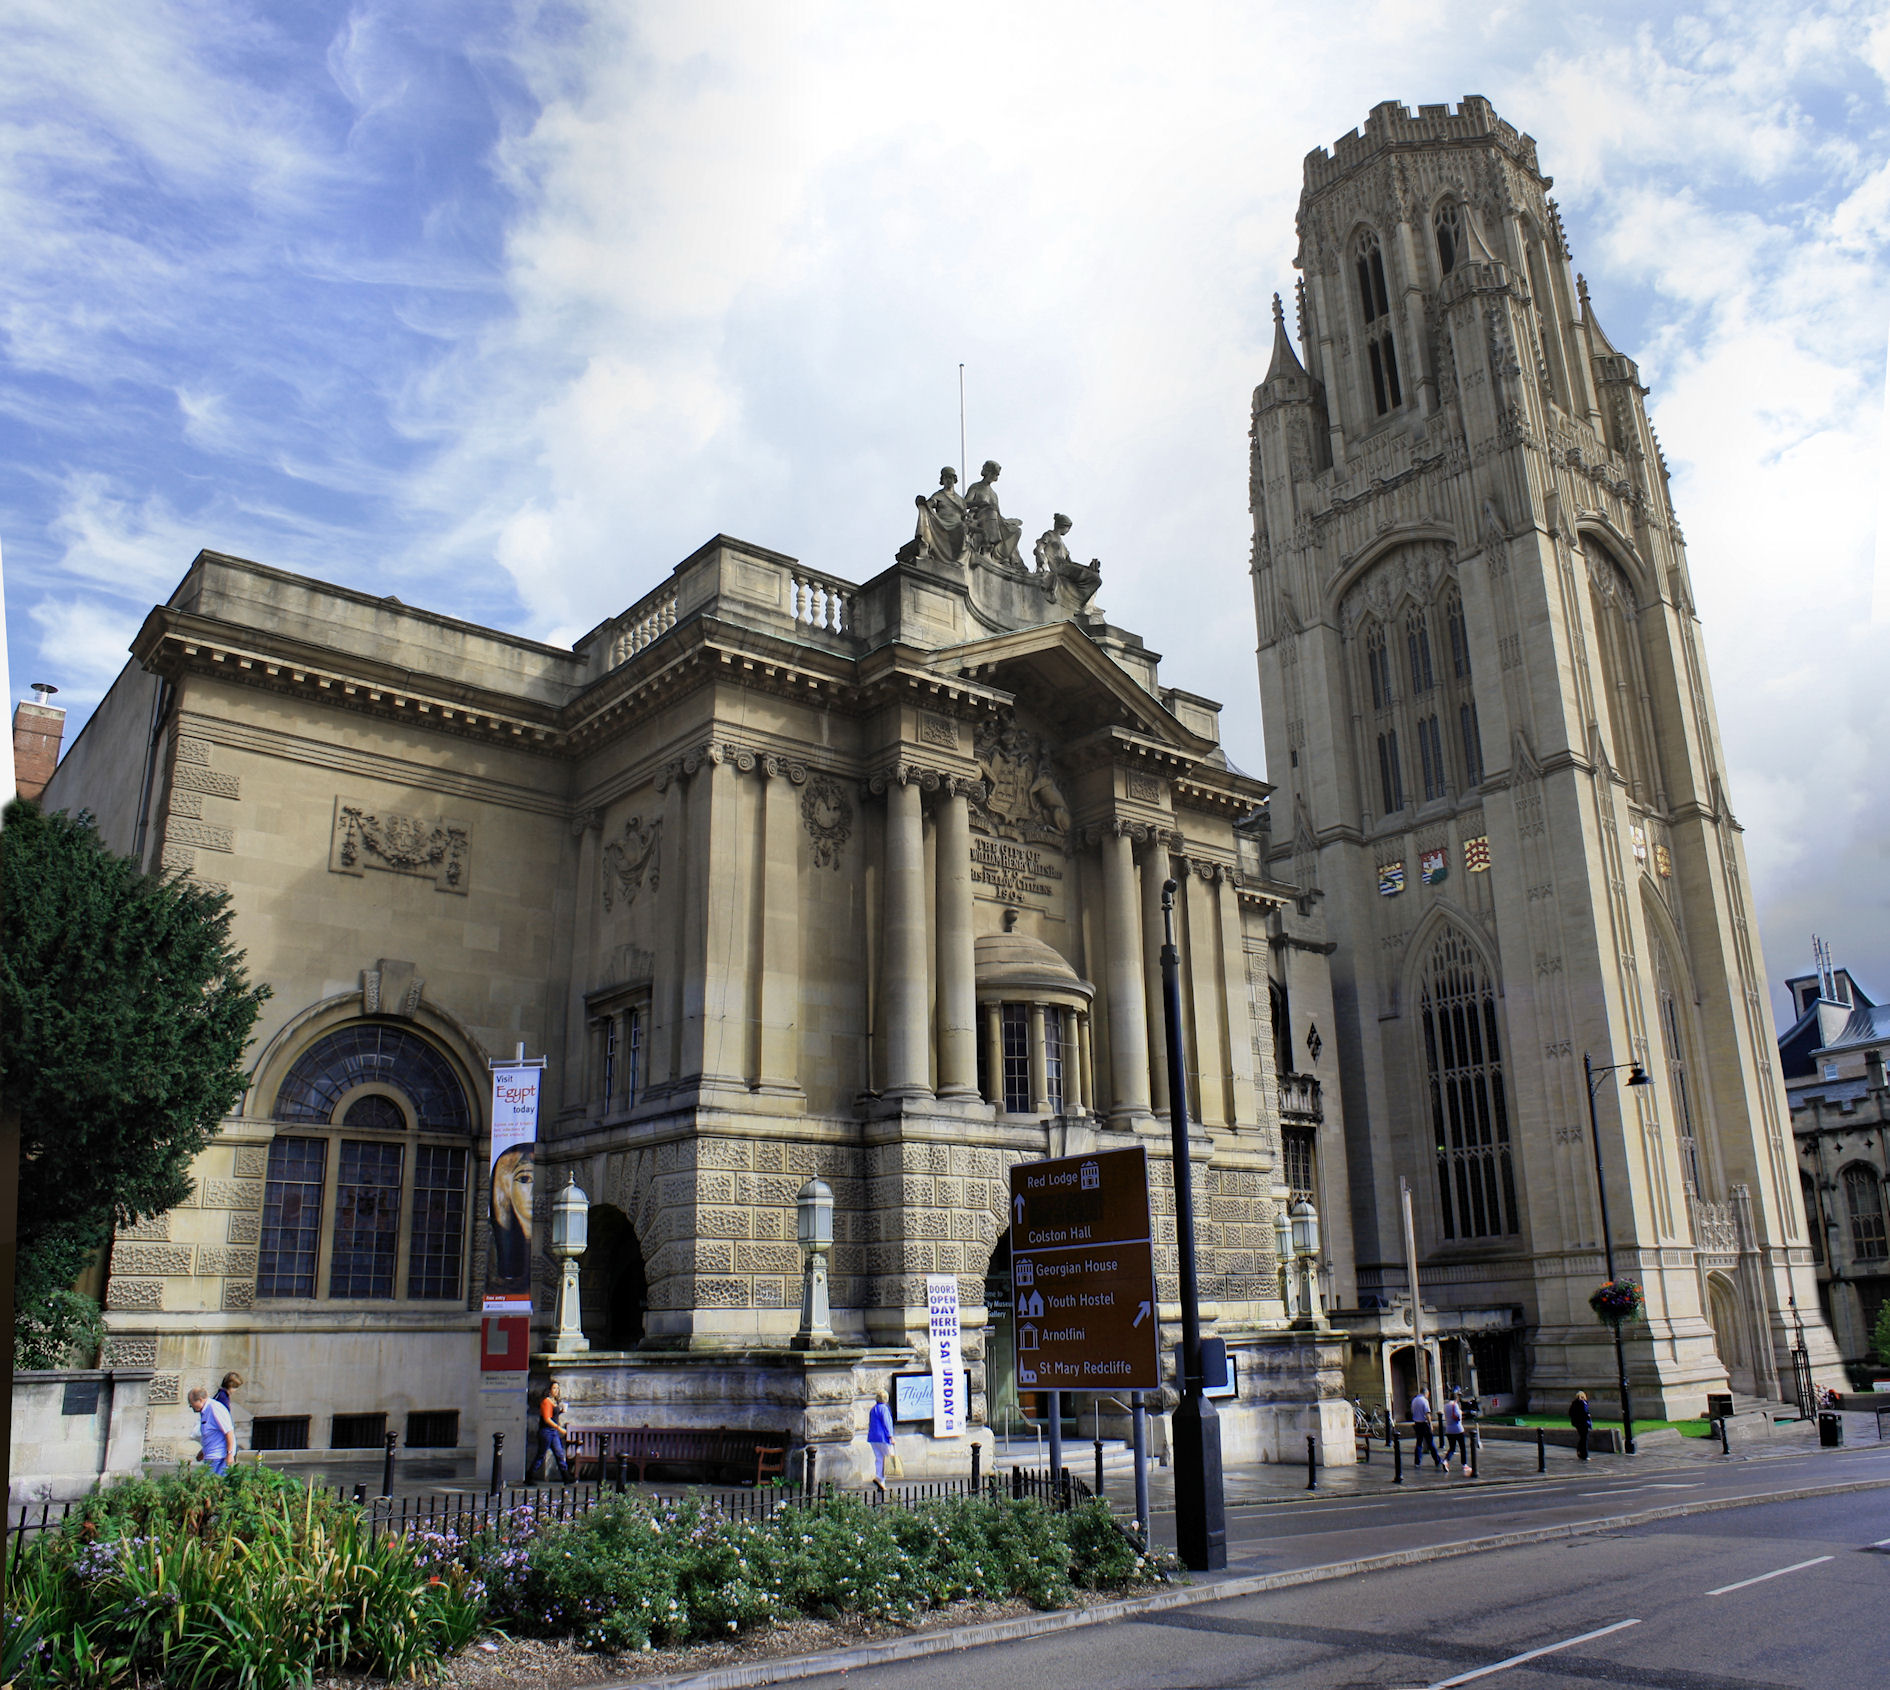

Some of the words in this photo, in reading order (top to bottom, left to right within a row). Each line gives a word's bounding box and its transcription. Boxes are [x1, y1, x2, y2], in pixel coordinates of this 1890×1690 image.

[975, 838, 998, 853] THE
[999, 842, 1025, 859] GIFT
[1026, 850, 1040, 863] OF
[970, 847, 1001, 867] WILLIAM
[1001, 855, 1026, 872] HENRY
[1027, 860, 1048, 877] WILLS
[1003, 868, 1018, 879] TO
[982, 870, 1015, 888] FELLOW
[1016, 880, 1053, 897] CITIZENS
[496, 1075, 513, 1083] Visit
[496, 1084, 537, 1104] Egypt
[513, 1105, 535, 1114] today
[1027, 1174, 1046, 1189] Red
[1048, 1171, 1078, 1186] Lodge
[1028, 1229, 1067, 1244] Colston
[1070, 1225, 1092, 1239] Hall
[1036, 1261, 1082, 1277] Georgian
[1084, 1259, 1118, 1273] House
[929, 1284, 956, 1294] DOORS
[930, 1295, 956, 1304] OPEN
[993, 1300, 1013, 1308] Museu
[1047, 1294, 1077, 1308] Youth
[1079, 1291, 1115, 1306] Hostel
[930, 1305, 956, 1315] DAY
[931, 1317, 958, 1327] HERE
[932, 1328, 958, 1337] THIS
[1042, 1327, 1086, 1341] Arnolfini
[1040, 1361, 1051, 1375] St
[1054, 1361, 1080, 1377] Mary
[1083, 1360, 1132, 1375] Redcliffe
[940, 1340, 955, 1416] SATURDAY
